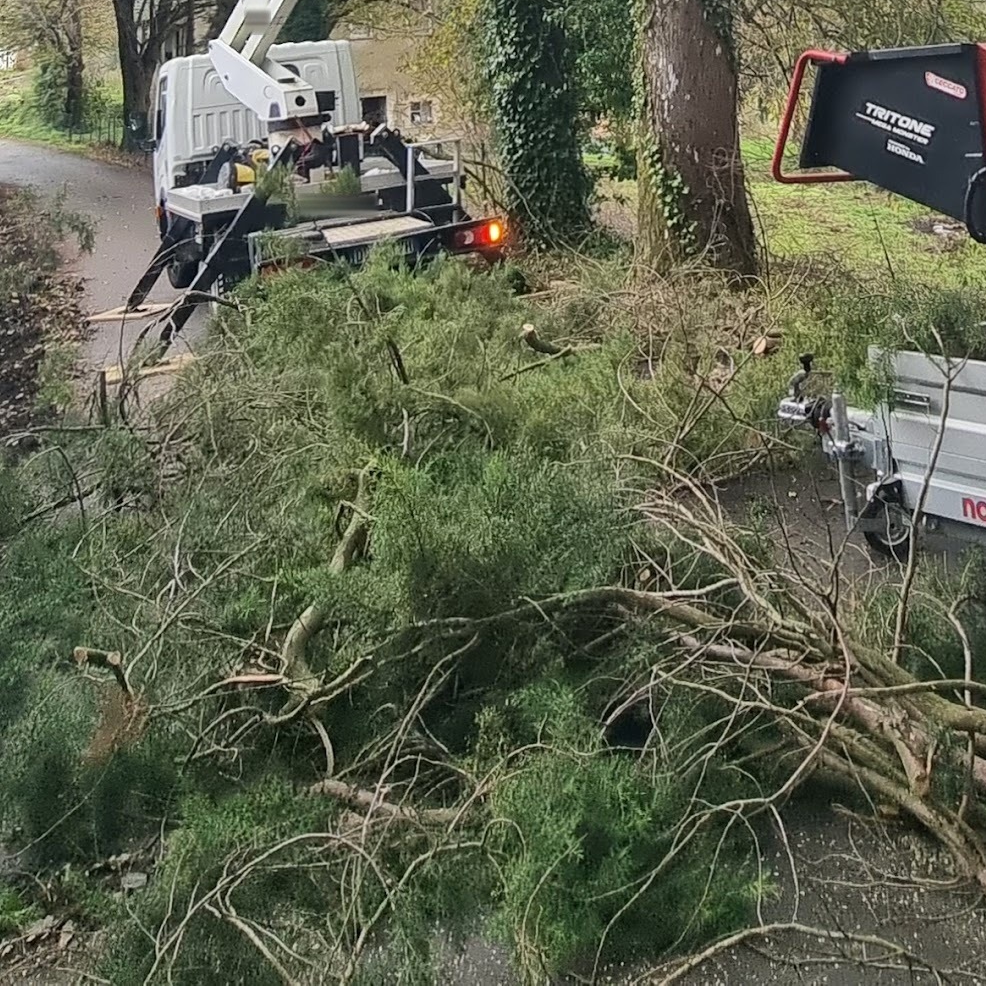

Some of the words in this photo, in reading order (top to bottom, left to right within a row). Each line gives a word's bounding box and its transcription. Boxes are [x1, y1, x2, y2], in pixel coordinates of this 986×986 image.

[934, 77, 965, 94] CECCATO
[865, 101, 936, 138] TRITONE
[892, 126, 929, 145] MONSTER
[886, 142, 926, 165] HONDA
